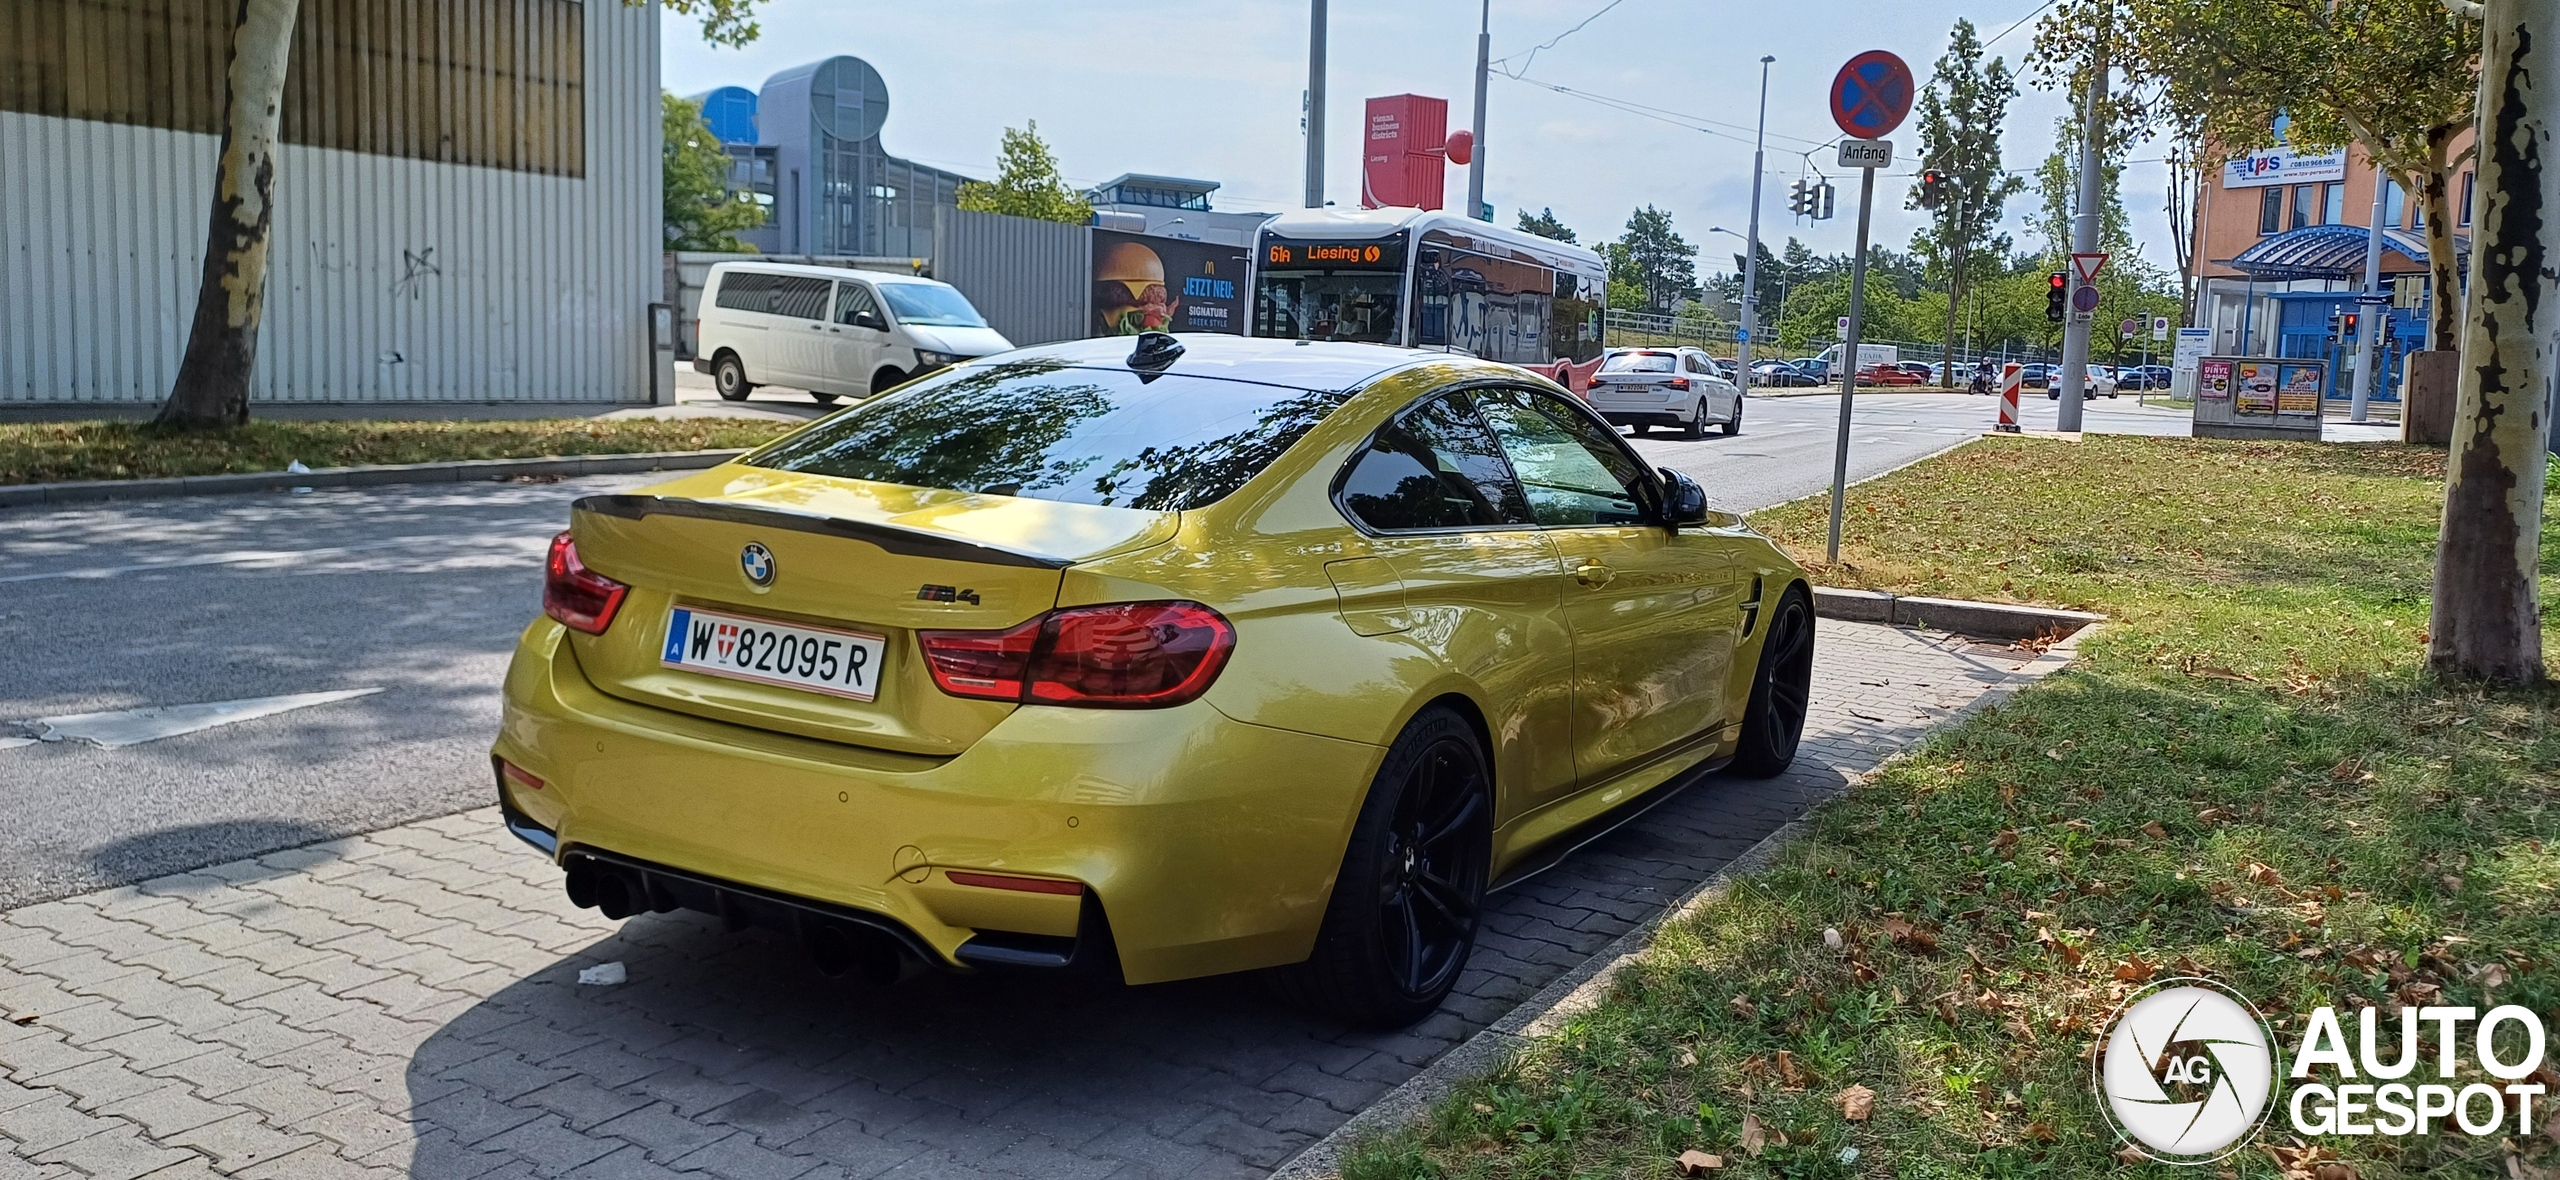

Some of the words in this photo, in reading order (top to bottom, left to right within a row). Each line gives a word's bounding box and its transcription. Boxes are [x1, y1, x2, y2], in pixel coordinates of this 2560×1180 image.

[1372, 114, 1394, 123] vienna
[1372, 122, 1399, 131] business
[1371, 130, 1398, 140] districts
[1844, 145, 1887, 163] Anfang
[2246, 154, 2281, 176] tps
[2323, 158, 2336, 166] 900
[1269, 245, 1291, 263] 61A
[1307, 245, 1360, 263] Liesing
[1183, 276, 1212, 297] JETZT
[1212, 280, 1234, 299] NEU:
[1188, 305, 1228, 318] SIGNATURE
[1188, 317, 1208, 327] GREEK
[1209, 318, 1228, 328] STYLE
[2204, 366, 2229, 374] VINYL
[742, 545, 771, 561] BMW
[670, 642, 680, 656] A
[691, 619, 716, 661] W
[736, 627, 842, 682] 82095
[844, 644, 869, 688] R
